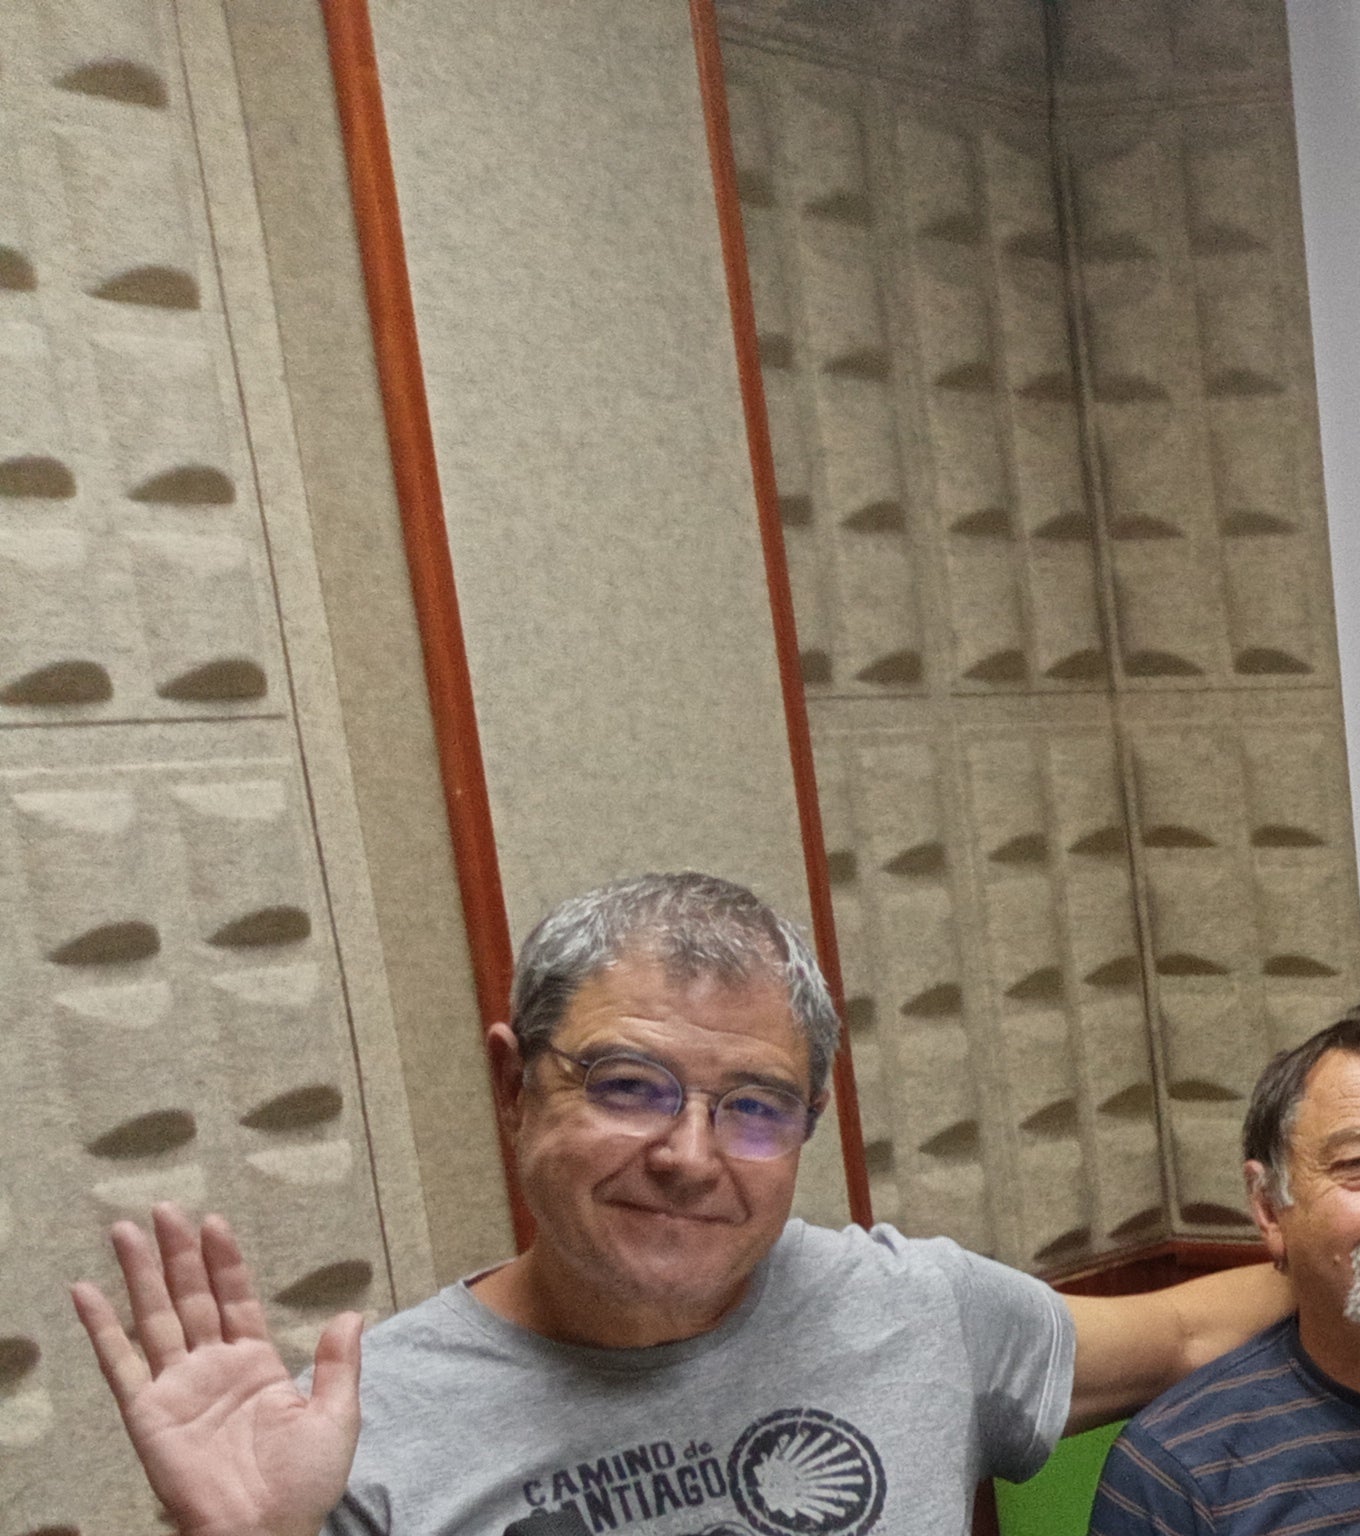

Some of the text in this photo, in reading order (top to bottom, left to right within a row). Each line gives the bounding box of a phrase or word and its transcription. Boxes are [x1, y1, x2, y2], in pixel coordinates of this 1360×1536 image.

[523, 1440, 713, 1507] CAMINO de
[531, 1457, 727, 1534] NTIAGO
